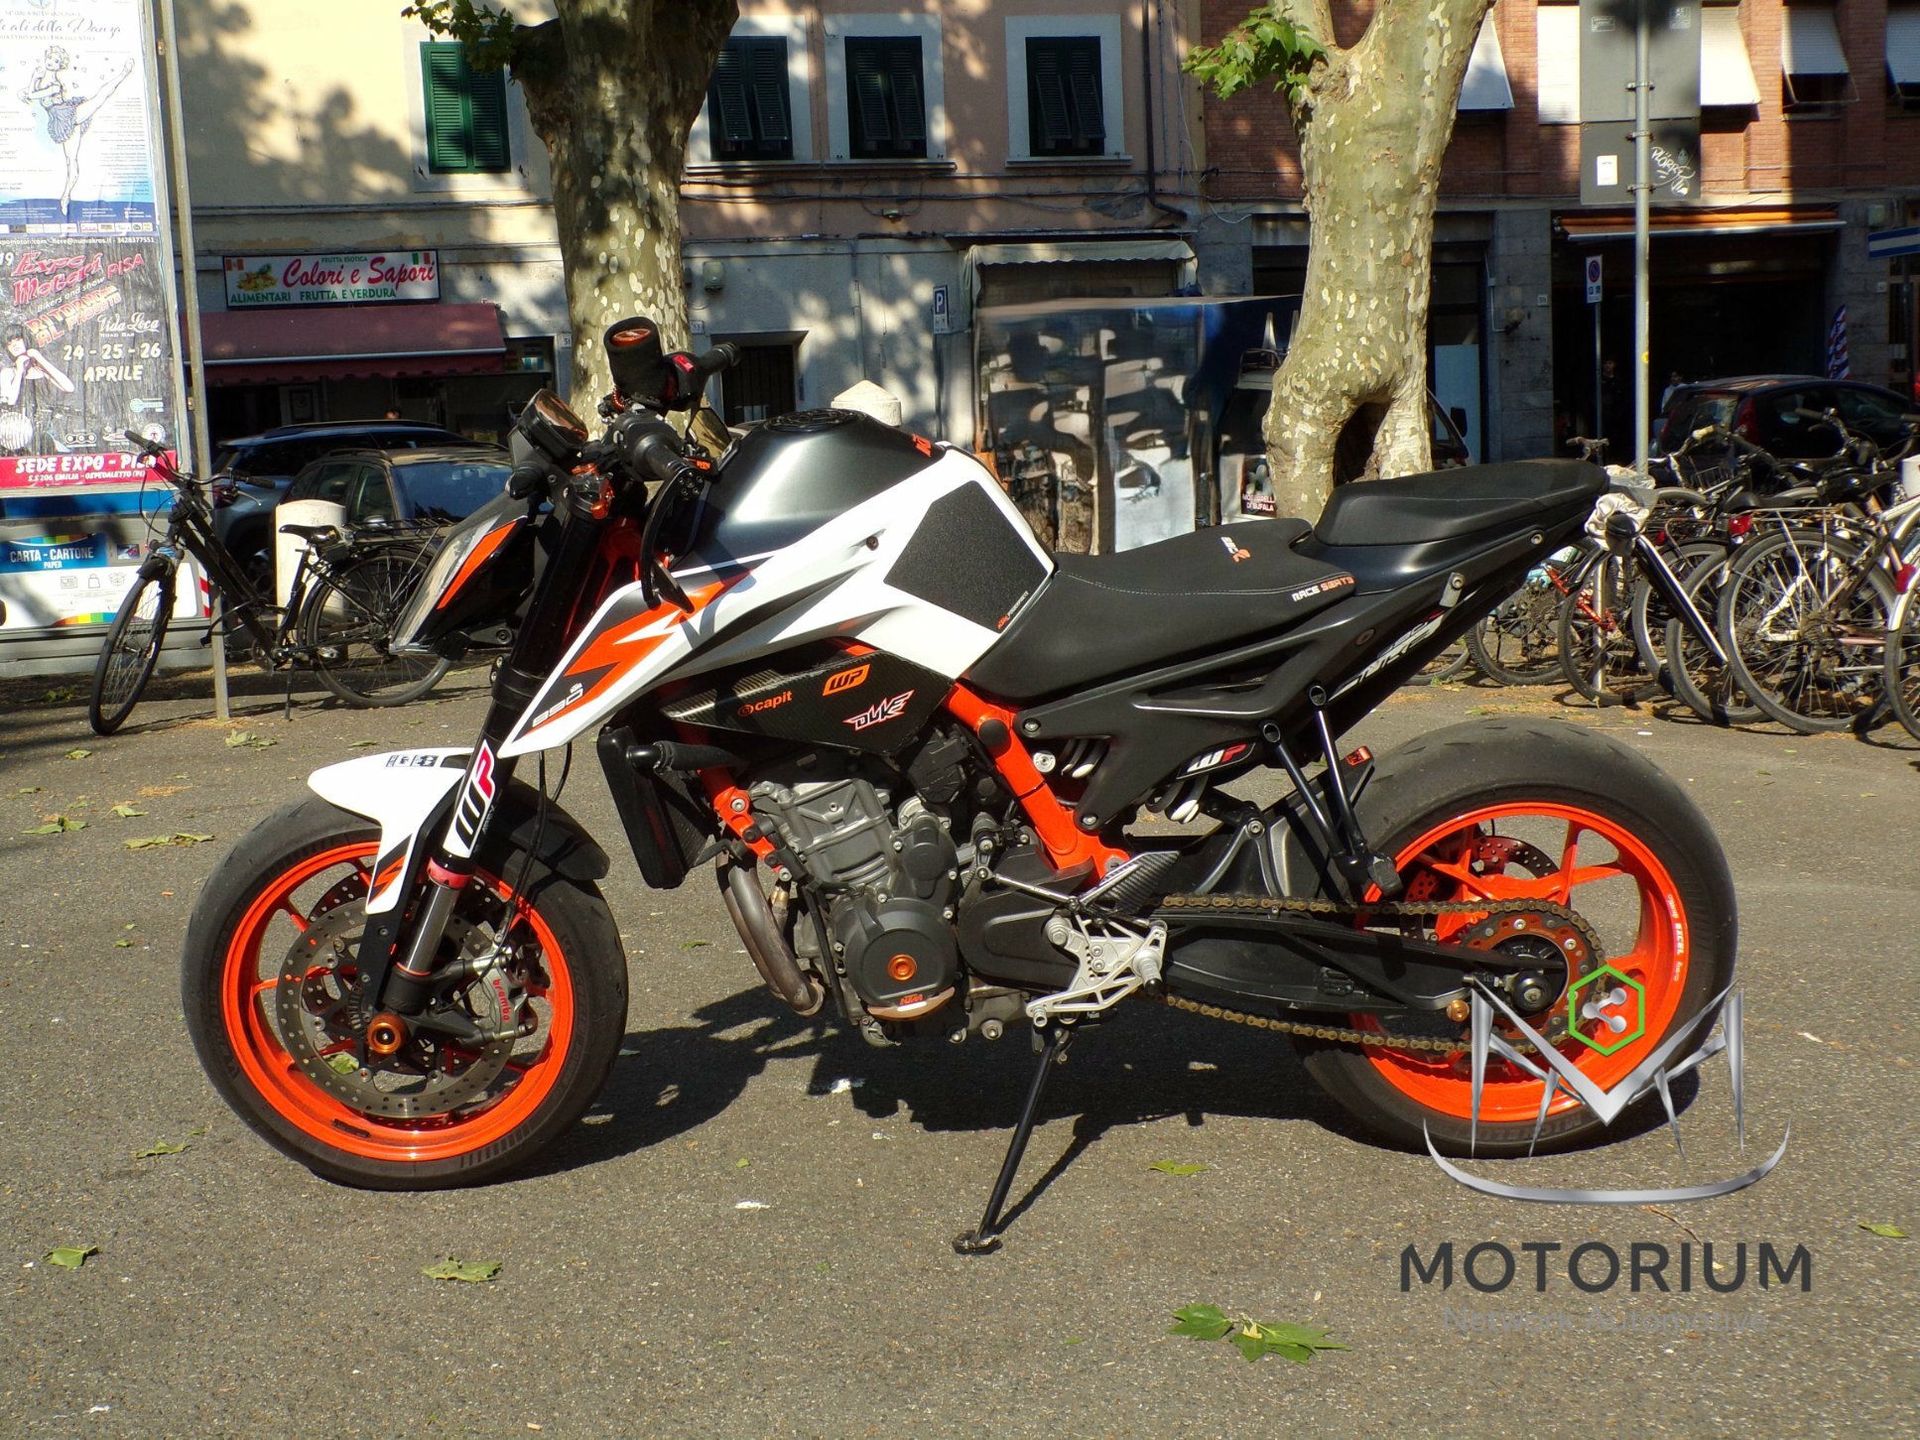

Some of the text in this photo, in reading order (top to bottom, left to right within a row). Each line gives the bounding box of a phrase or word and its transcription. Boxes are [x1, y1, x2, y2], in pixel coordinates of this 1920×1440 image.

[107, 253, 145, 279] PISA
[283, 256, 436, 290] Colori e Sapori
[231, 288, 397, 303] ALIMENTARI FRUTTA E VERDURA
[127, 312, 160, 333] Loca
[63, 345, 84, 361] 24
[101, 343, 124, 360] 25
[140, 342, 161, 359] 26
[83, 364, 144, 382] APRILE
[16, 458, 57, 474] SEDE
[61, 456, 105, 472] EXPO
[10, 550, 42, 563] CARTA
[49, 547, 94, 561] CARTONE
[755, 690, 793, 714] capit
[492, 978, 512, 1022] brembo
